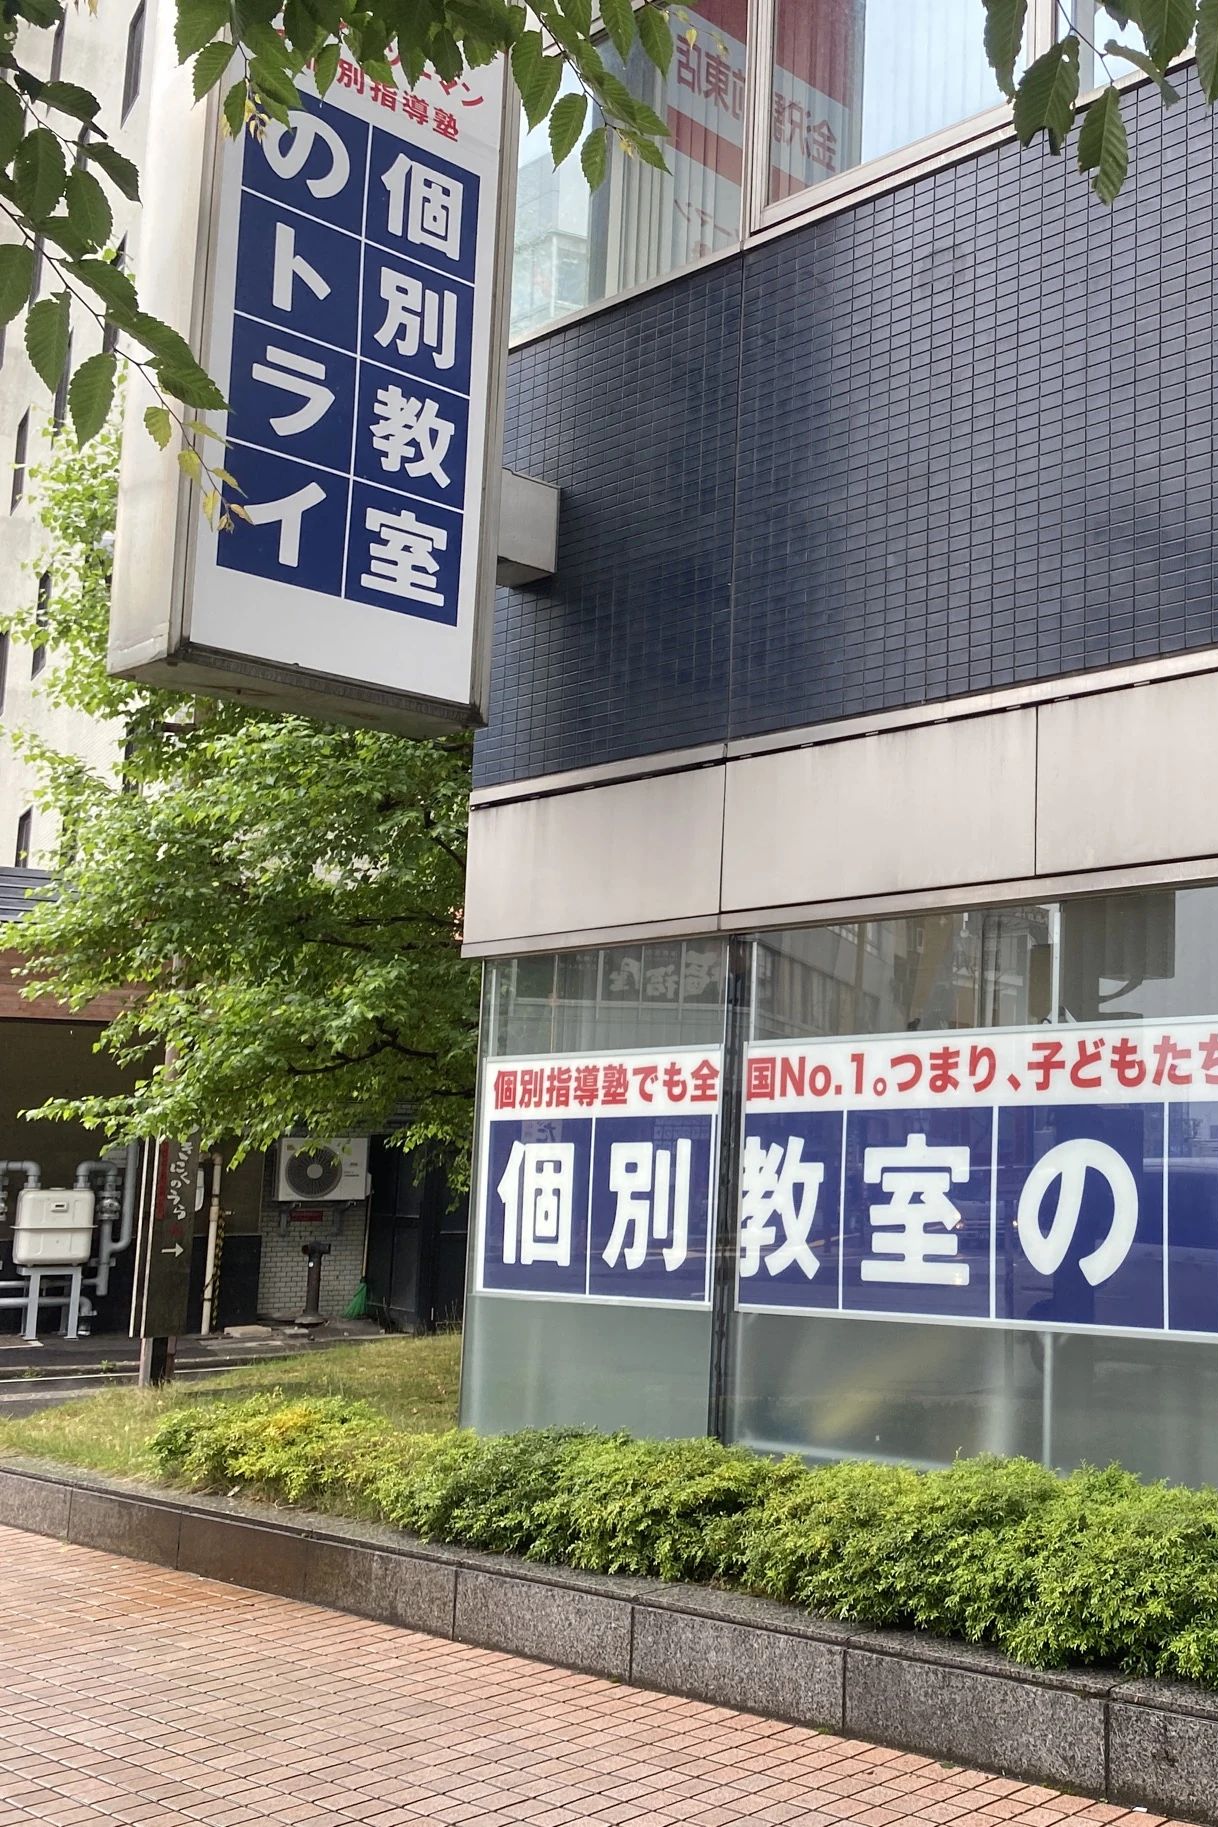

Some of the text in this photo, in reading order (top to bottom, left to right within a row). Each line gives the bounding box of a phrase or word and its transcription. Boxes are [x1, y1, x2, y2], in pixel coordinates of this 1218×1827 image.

[306, 57, 459, 142] 別指導塾
[244, 110, 351, 568] のトライ
[361, 153, 465, 608] 個別教室
